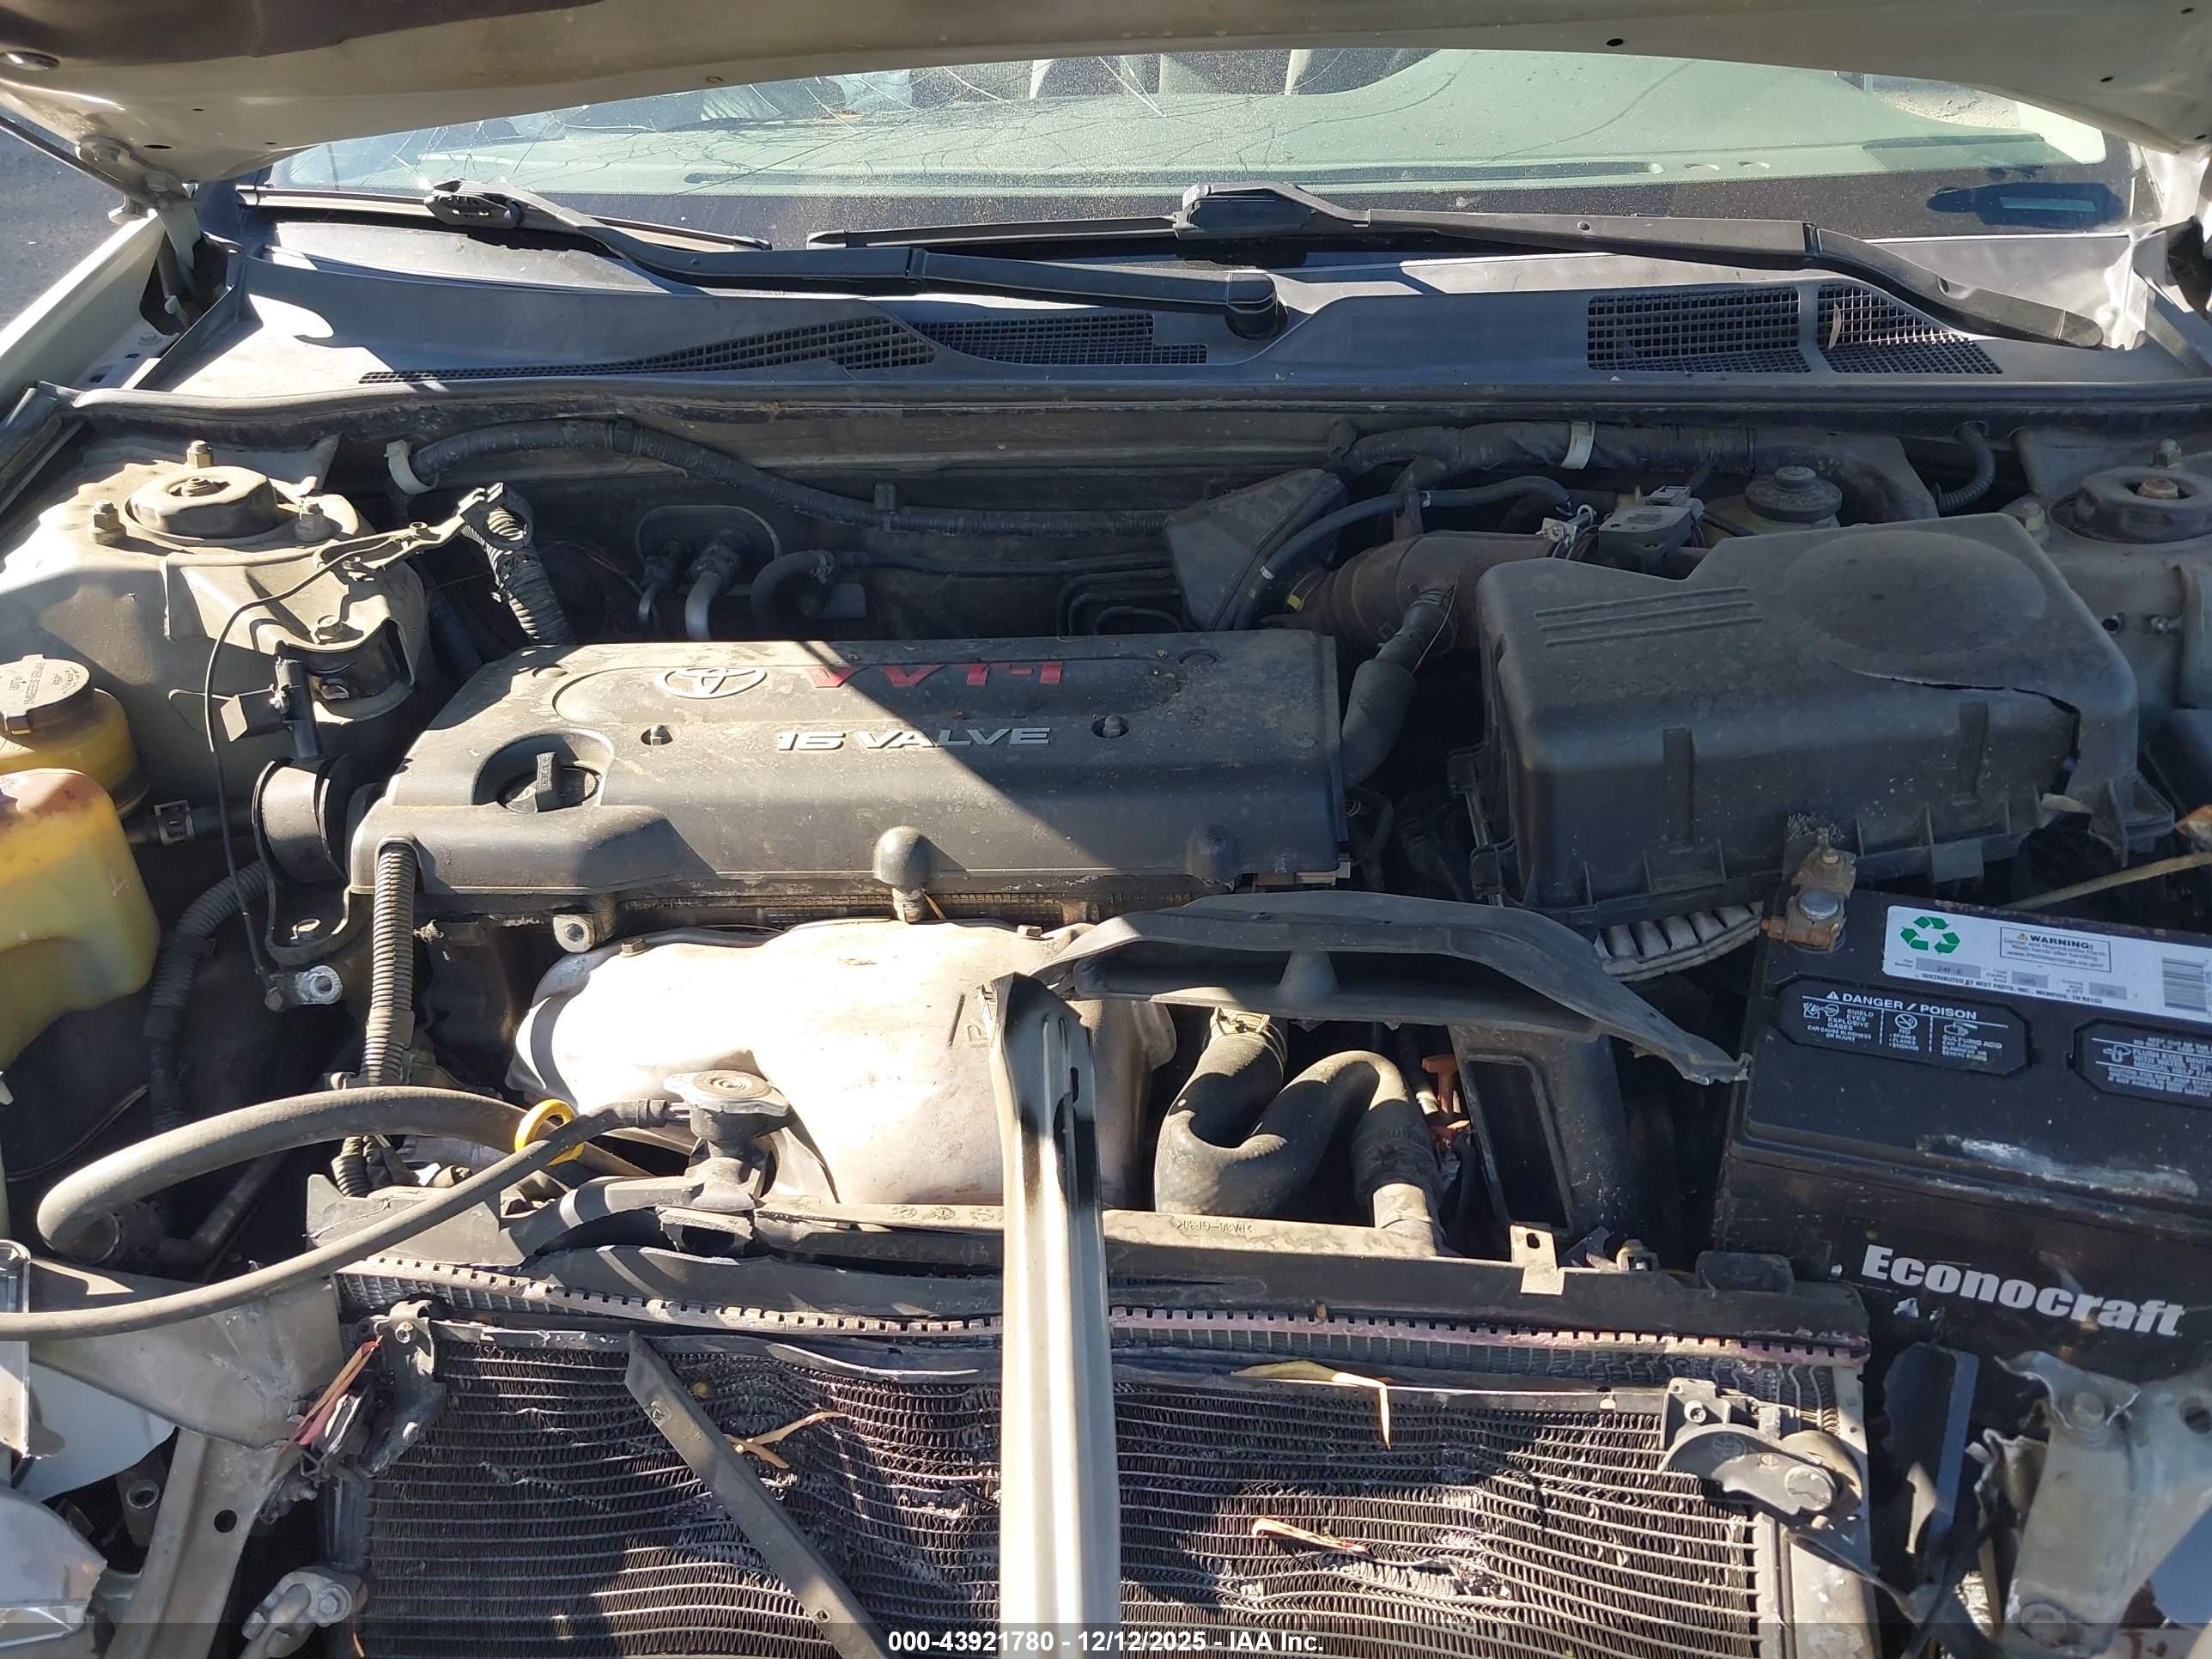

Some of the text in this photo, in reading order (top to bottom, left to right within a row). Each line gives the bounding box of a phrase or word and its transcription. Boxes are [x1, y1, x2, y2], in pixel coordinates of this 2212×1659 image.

[858, 727, 1050, 749] VALVE
[1842, 993, 1904, 1011] DANGER
[1920, 1004, 1977, 1020] POISON
[1862, 1244, 2185, 1337] Econocraft
